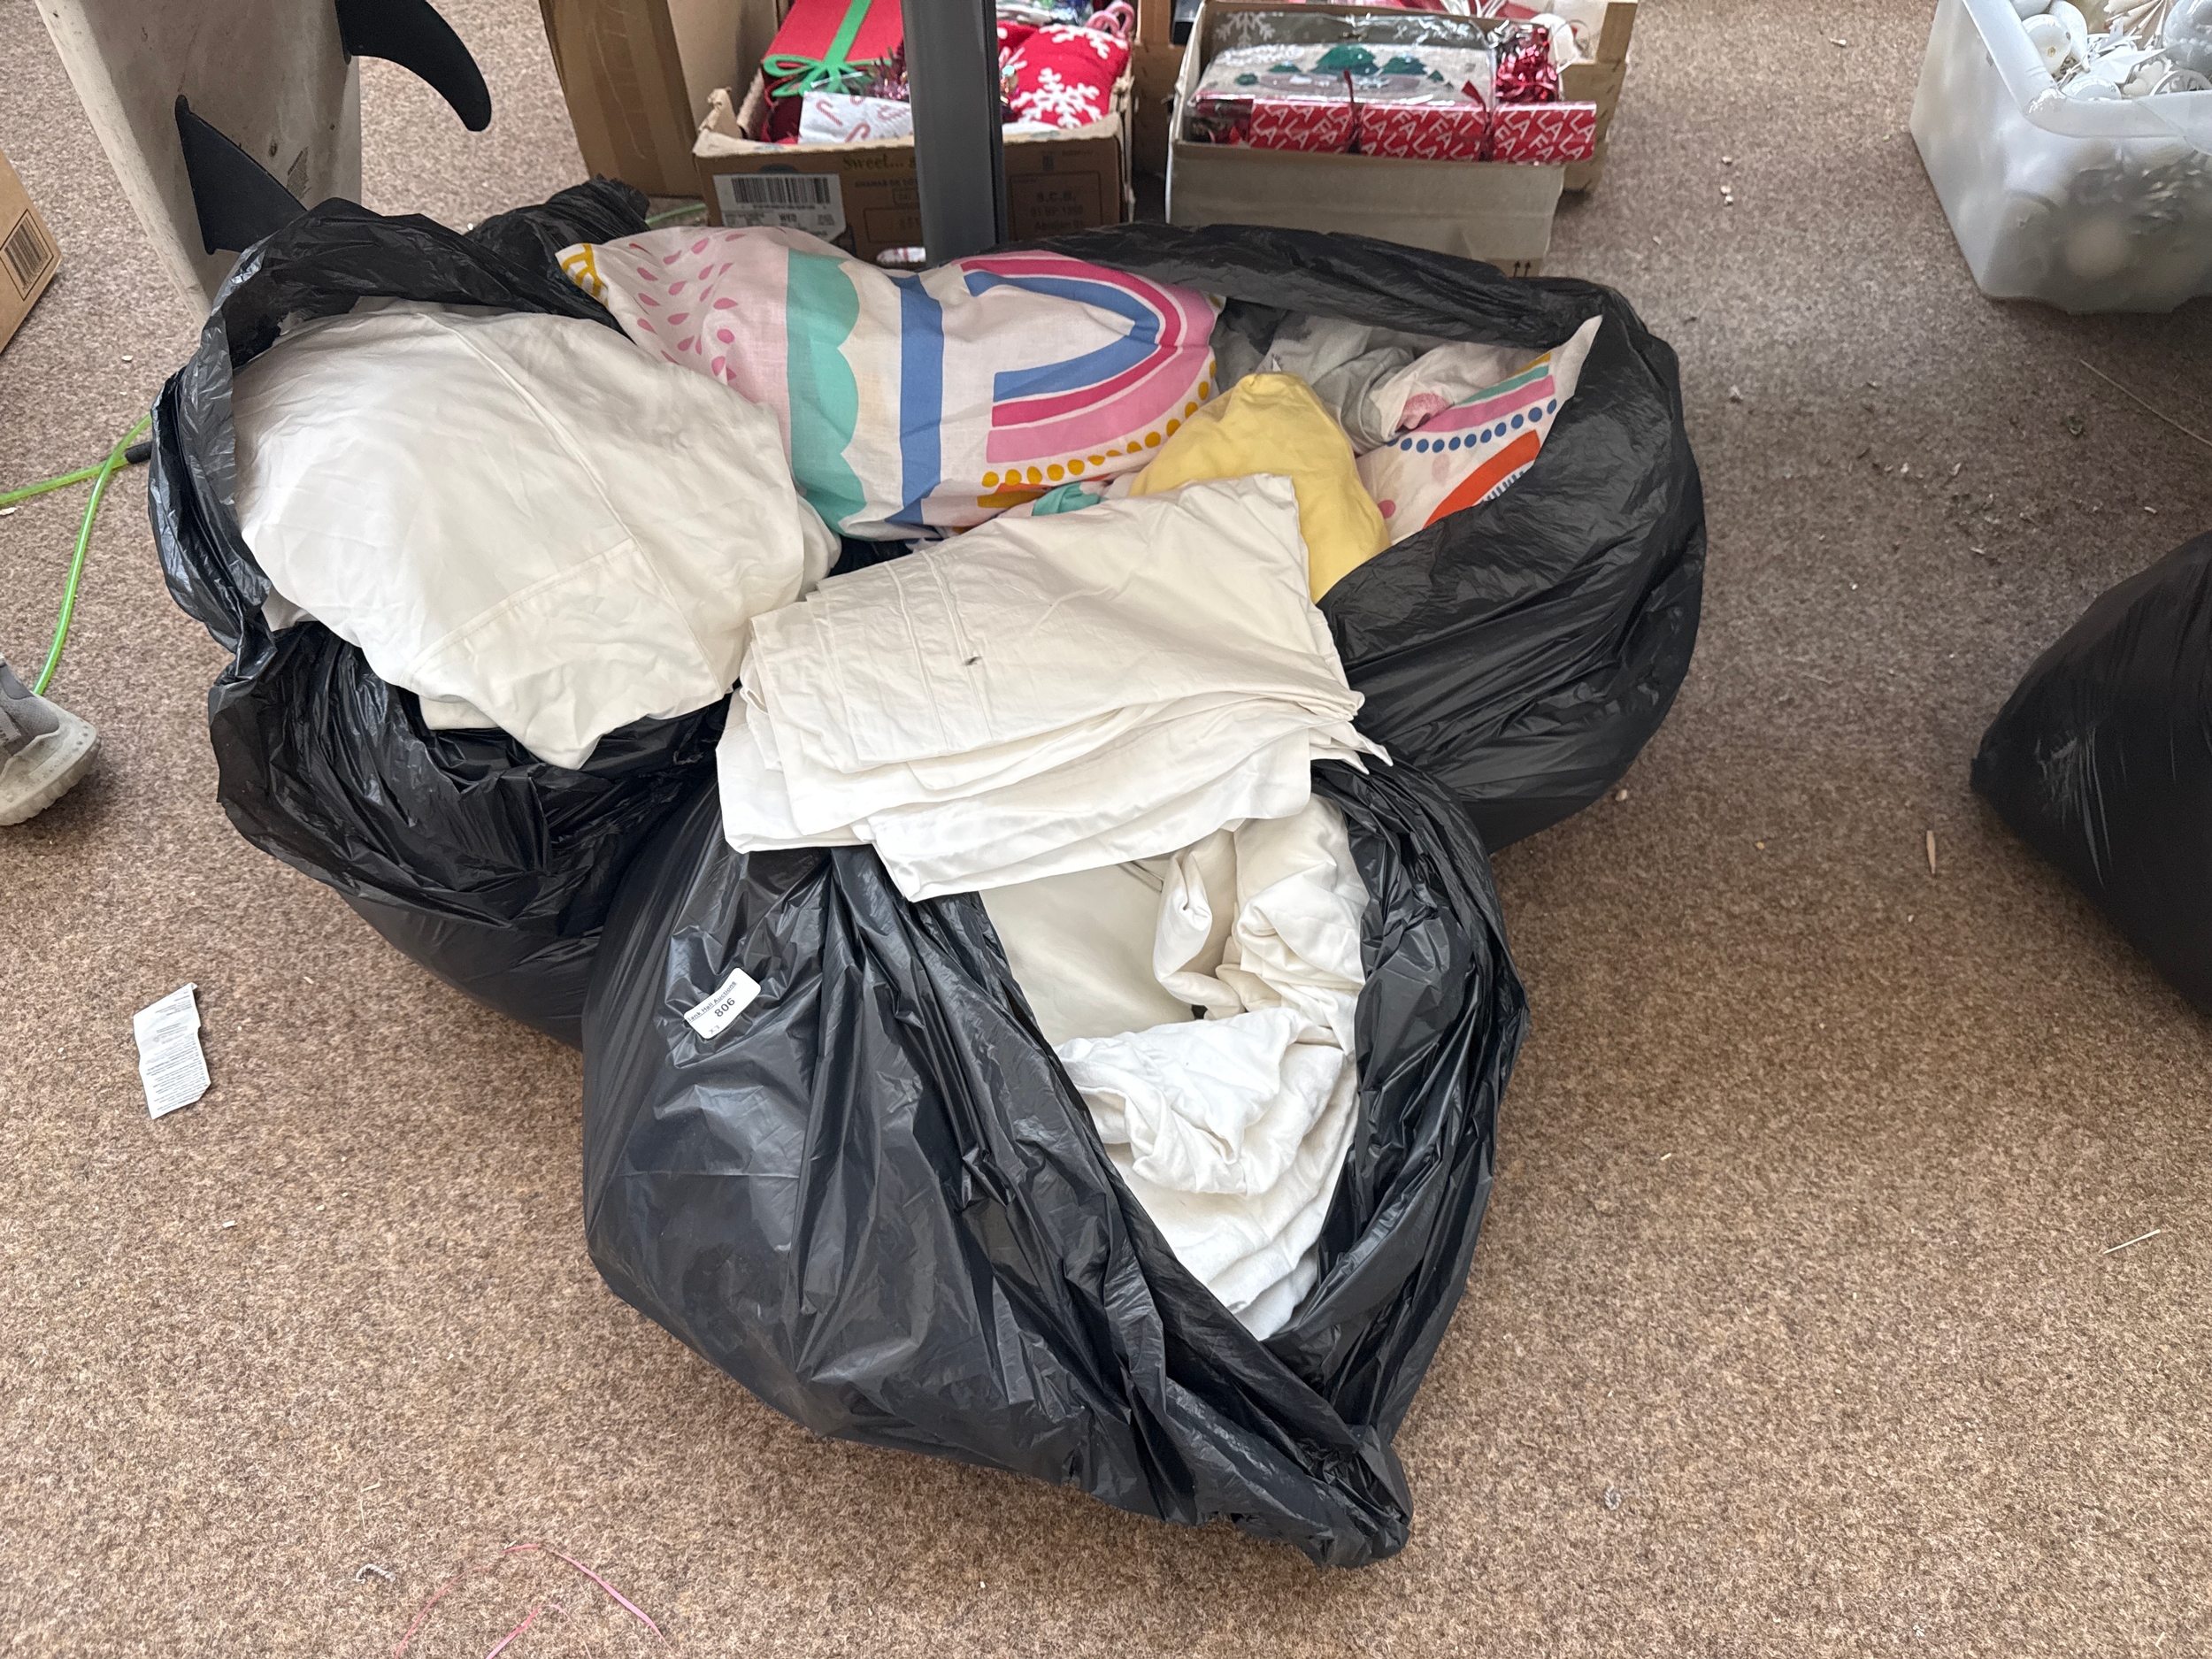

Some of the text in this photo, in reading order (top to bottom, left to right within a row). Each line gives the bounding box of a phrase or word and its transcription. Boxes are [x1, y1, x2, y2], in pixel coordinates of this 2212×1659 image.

[1253, 113, 1278, 145] LA
[1285, 118, 1310, 150] LA
[1311, 118, 1339, 144] FA
[1363, 110, 1387, 140] LA
[1383, 132, 1409, 158] LA
[1391, 111, 1417, 142] FA
[1413, 133, 1438, 159] LA
[1428, 118, 1453, 150] FA
[1505, 111, 1531, 140] LA
[1537, 111, 1564, 142] LA
[1559, 133, 1586, 160] LA
[1570, 112, 1596, 143] LA
[701, 1002, 714, 1013] Hall
[713, 981, 737, 1004] Auctions
[714, 997, 735, 1018] 806
